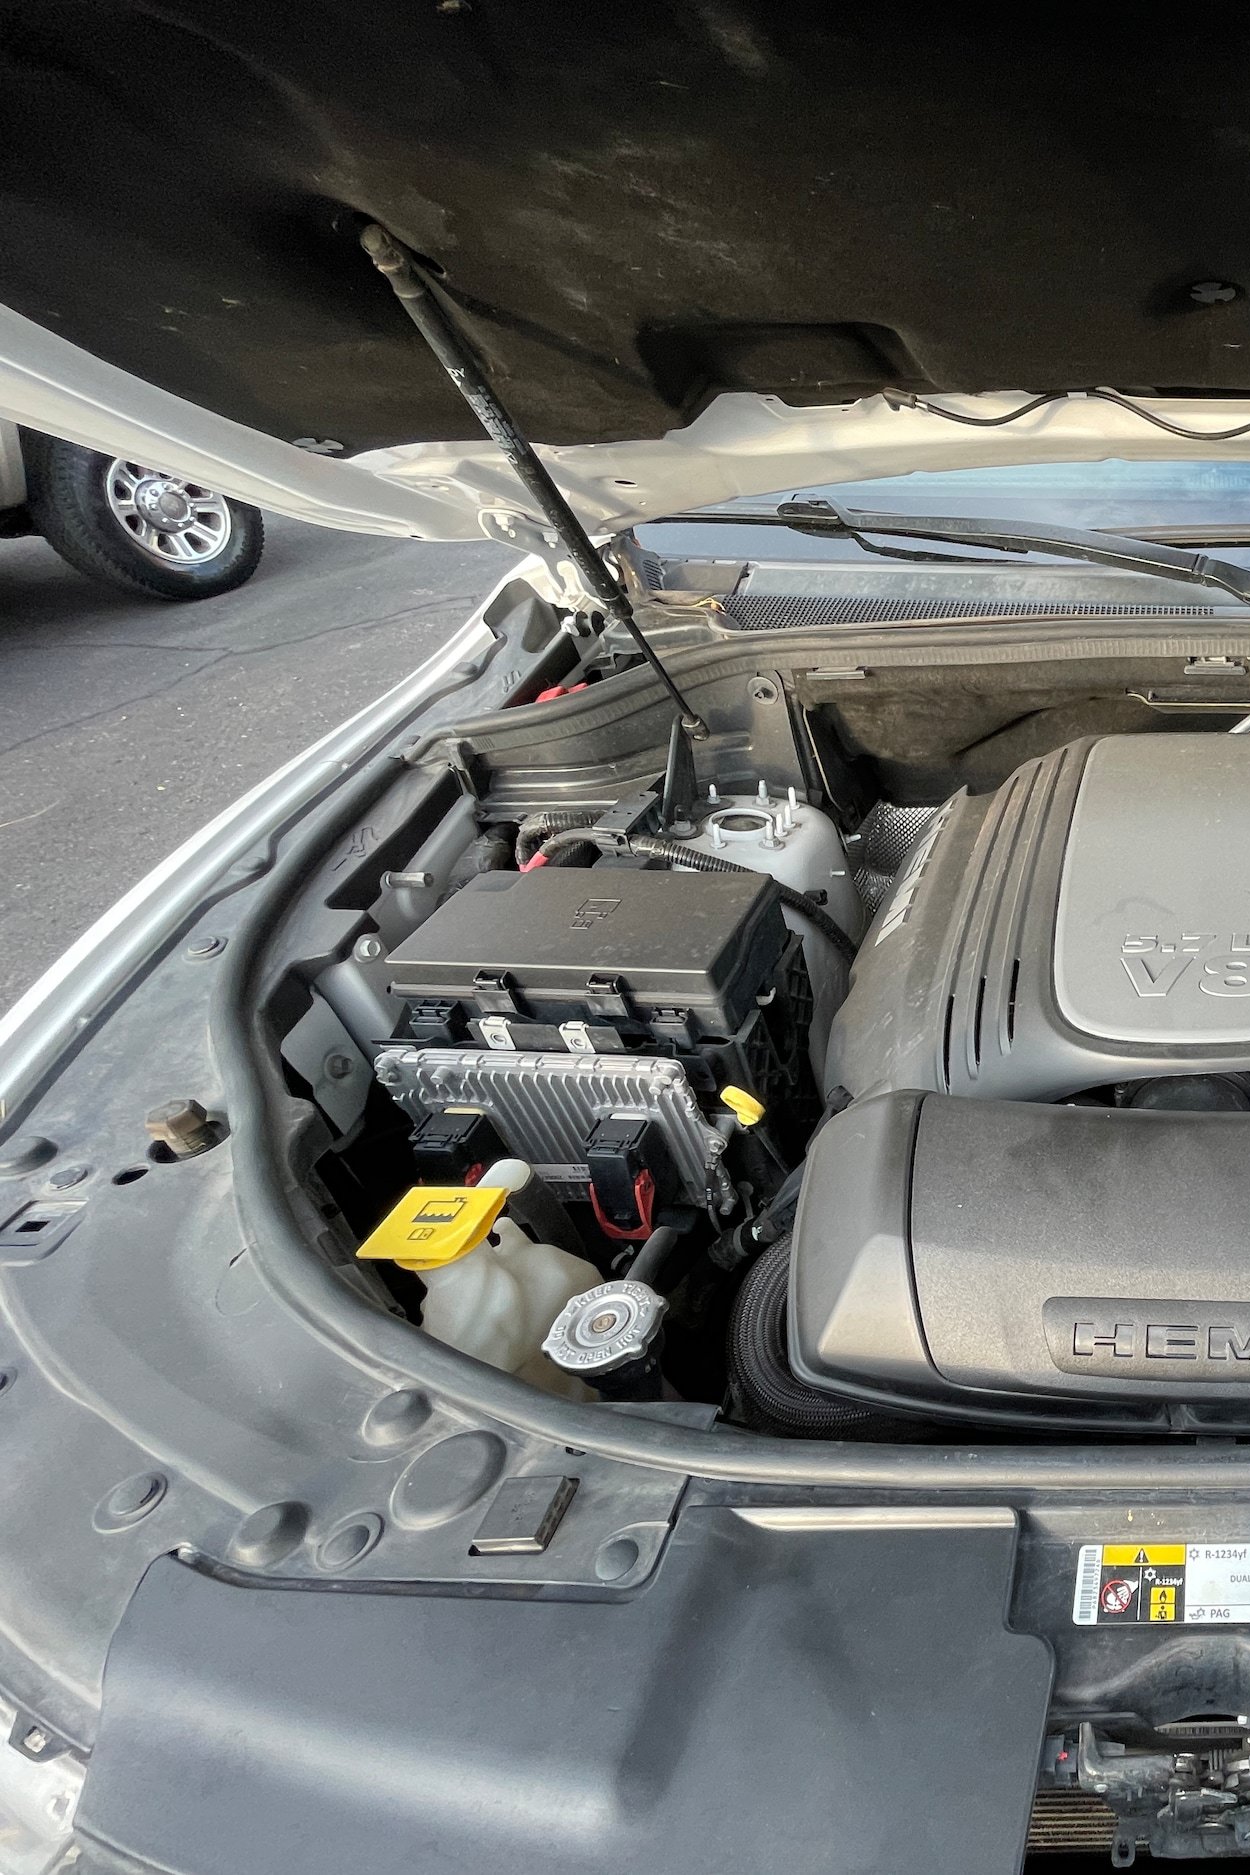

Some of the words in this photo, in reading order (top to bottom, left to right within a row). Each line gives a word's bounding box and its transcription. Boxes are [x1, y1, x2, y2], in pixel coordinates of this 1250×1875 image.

[578, 1346, 612, 1364] OPEN
[615, 1326, 641, 1350] HOT
[1205, 1548, 1247, 1560] R-1234yf
[1154, 1577, 1184, 1587] R-1234yf
[1210, 1608, 1231, 1618] PAG
